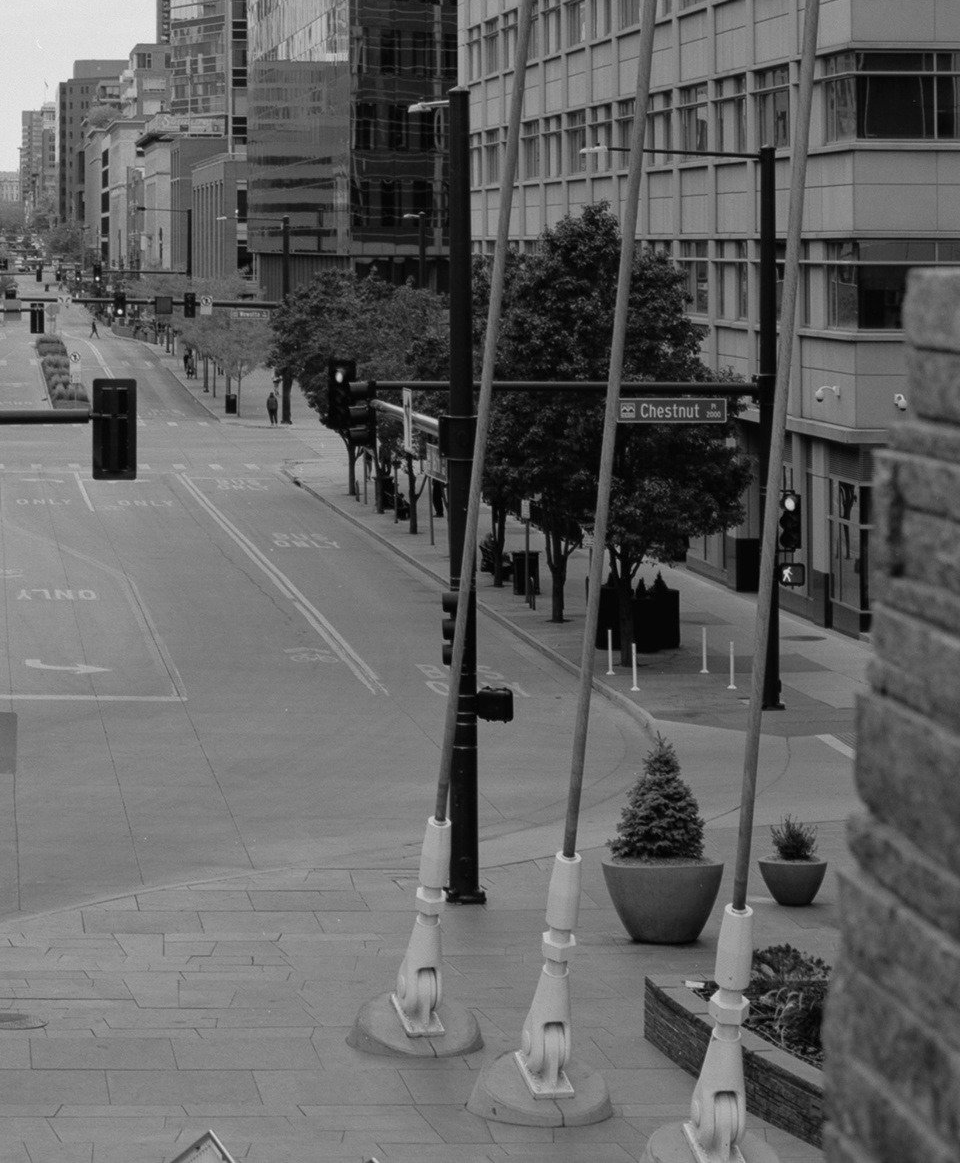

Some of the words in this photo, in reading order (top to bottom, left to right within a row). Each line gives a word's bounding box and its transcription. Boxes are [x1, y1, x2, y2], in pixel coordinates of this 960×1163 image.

[640, 403, 700, 419] Chestnut
[706, 411, 721, 419] 2000
[15, 498, 72, 506] ONLY
[117, 499, 174, 507] ONLY
[272, 540, 341, 549] ONLY
[16, 588, 98, 601] ONLY
